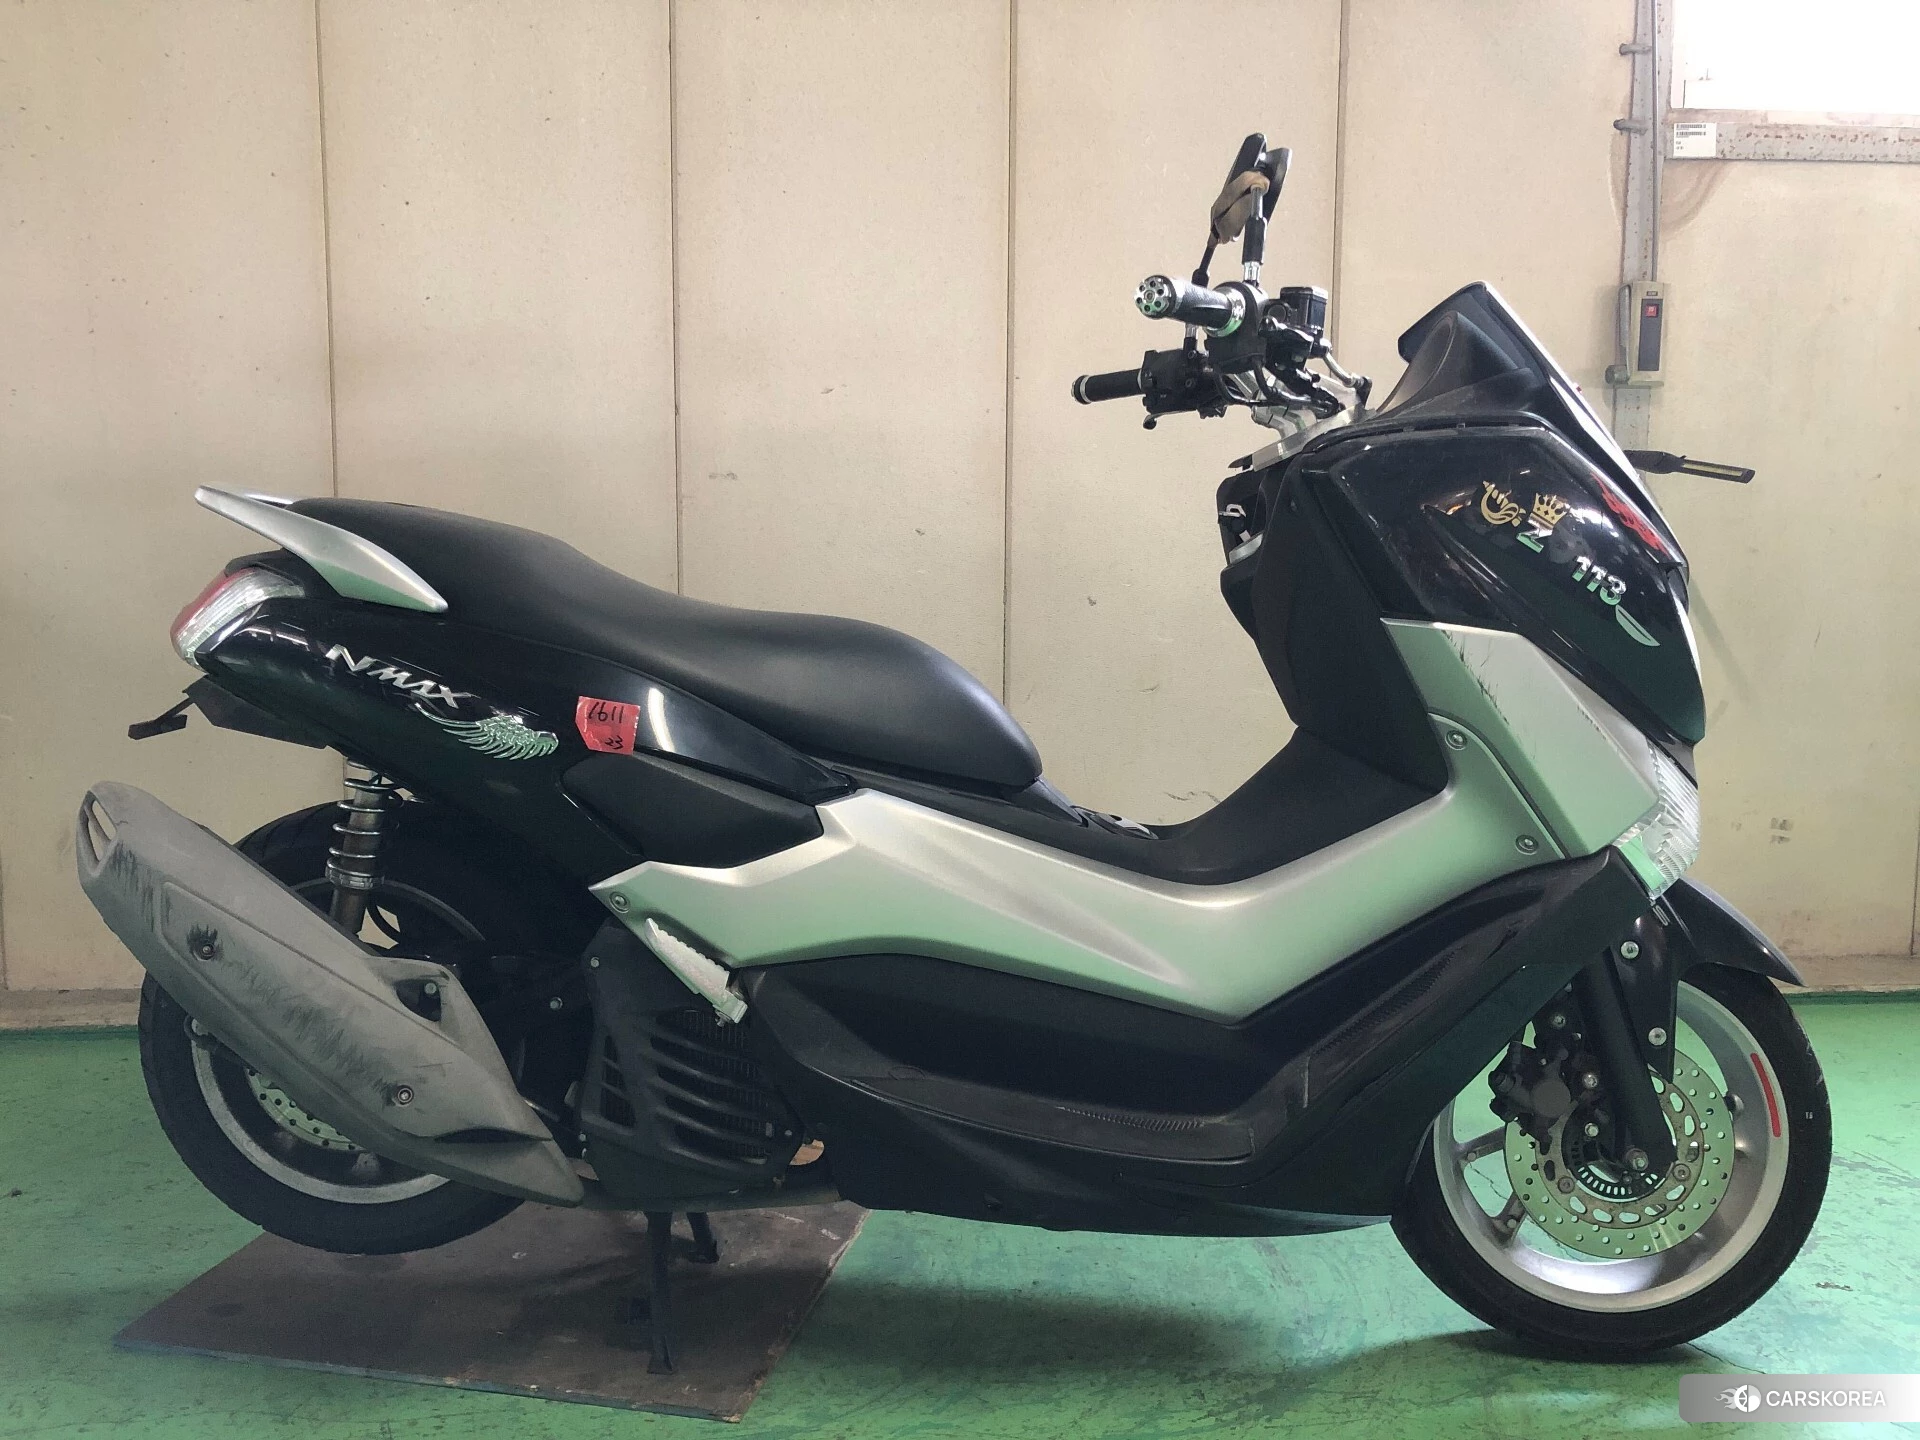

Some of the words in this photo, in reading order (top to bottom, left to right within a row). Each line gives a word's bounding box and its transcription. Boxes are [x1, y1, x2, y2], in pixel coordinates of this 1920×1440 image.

[1572, 556, 1627, 606] 113
[325, 644, 472, 709] NMAX
[588, 702, 623, 723] 1611
